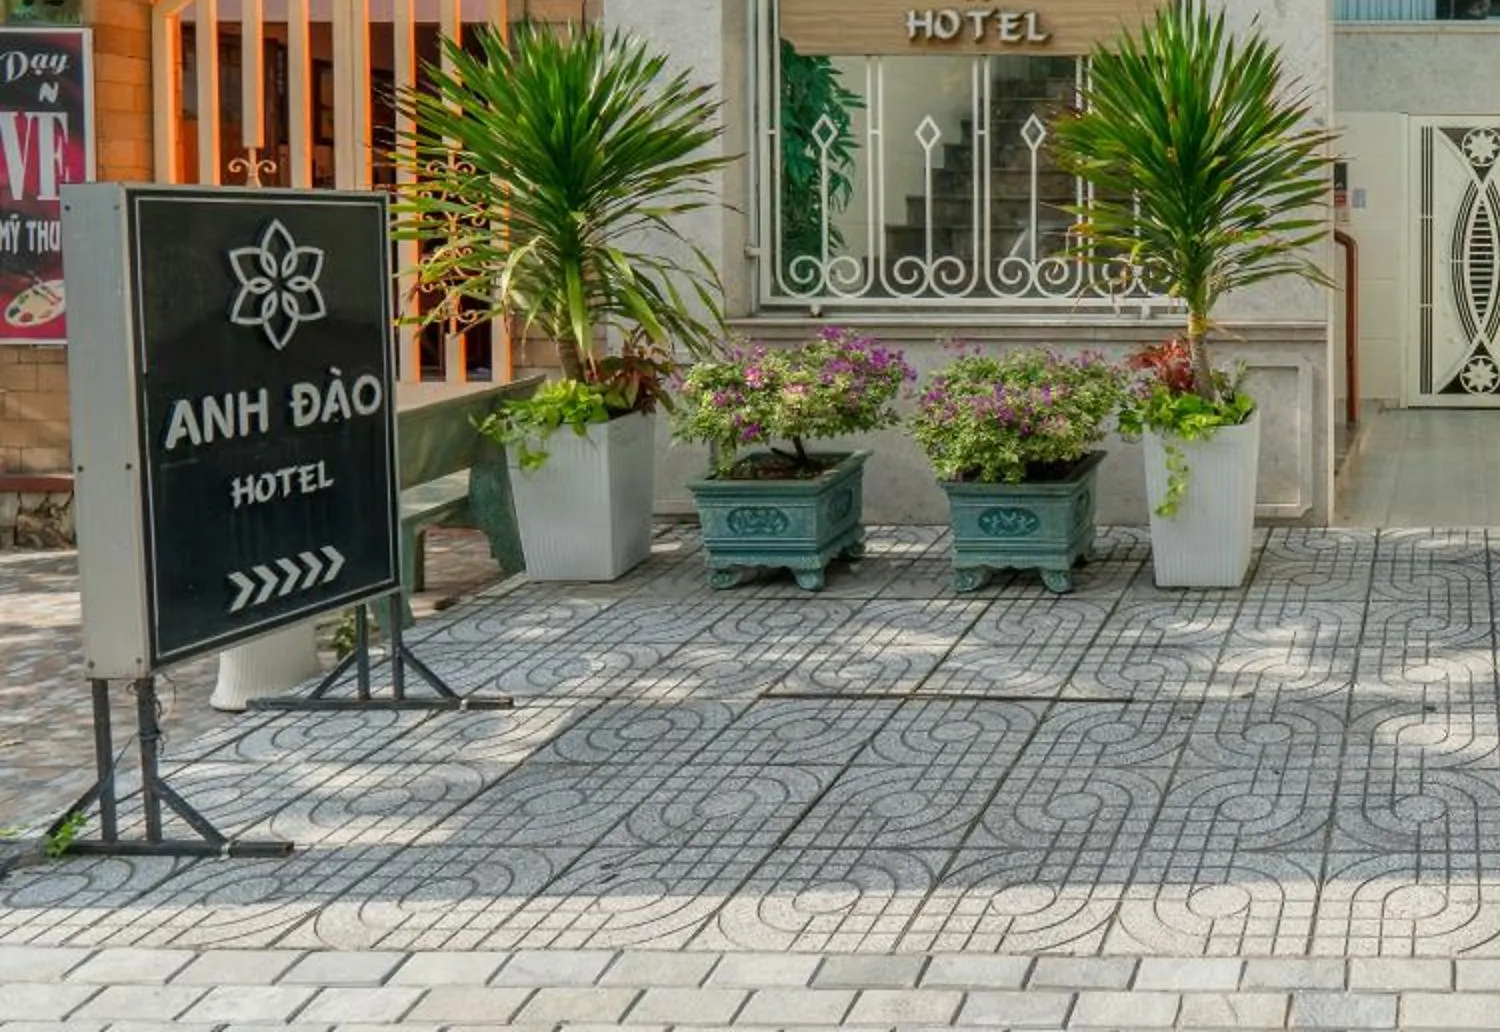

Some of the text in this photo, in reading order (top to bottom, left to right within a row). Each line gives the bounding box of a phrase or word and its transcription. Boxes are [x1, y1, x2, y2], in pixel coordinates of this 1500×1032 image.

[905, 9, 1050, 43] HOTEL
[25, 220, 61, 255] THU
[164, 367, 383, 451] ANH ĐÀO
[230, 459, 334, 510] HOTEL
